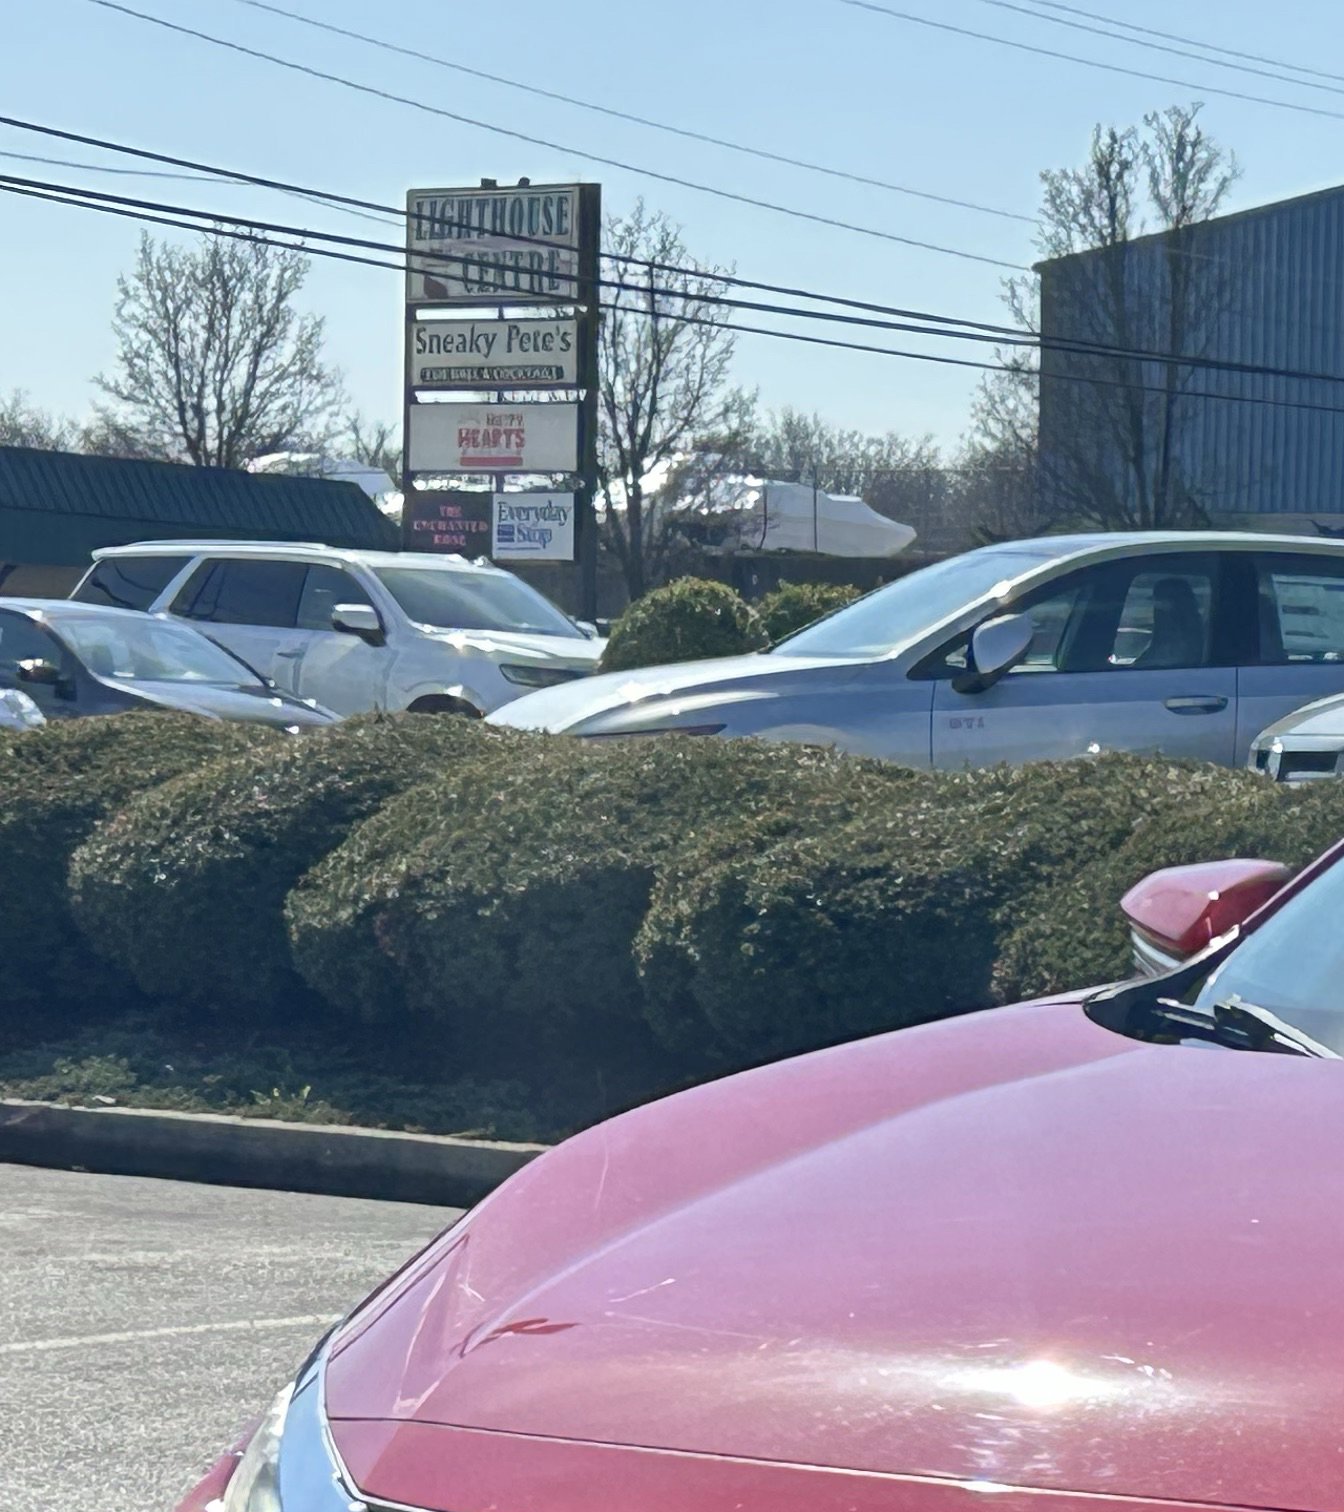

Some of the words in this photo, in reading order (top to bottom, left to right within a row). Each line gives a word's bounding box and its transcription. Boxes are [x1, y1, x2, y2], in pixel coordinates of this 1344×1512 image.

[415, 196, 568, 240] LIGHTHOUSE
[463, 250, 561, 293] CENTRE
[416, 324, 497, 358] Sneaky
[507, 325, 572, 353] Pete's
[458, 428, 525, 448] HEARTS
[497, 500, 573, 526] Everyday
[517, 523, 553, 548] Stop
